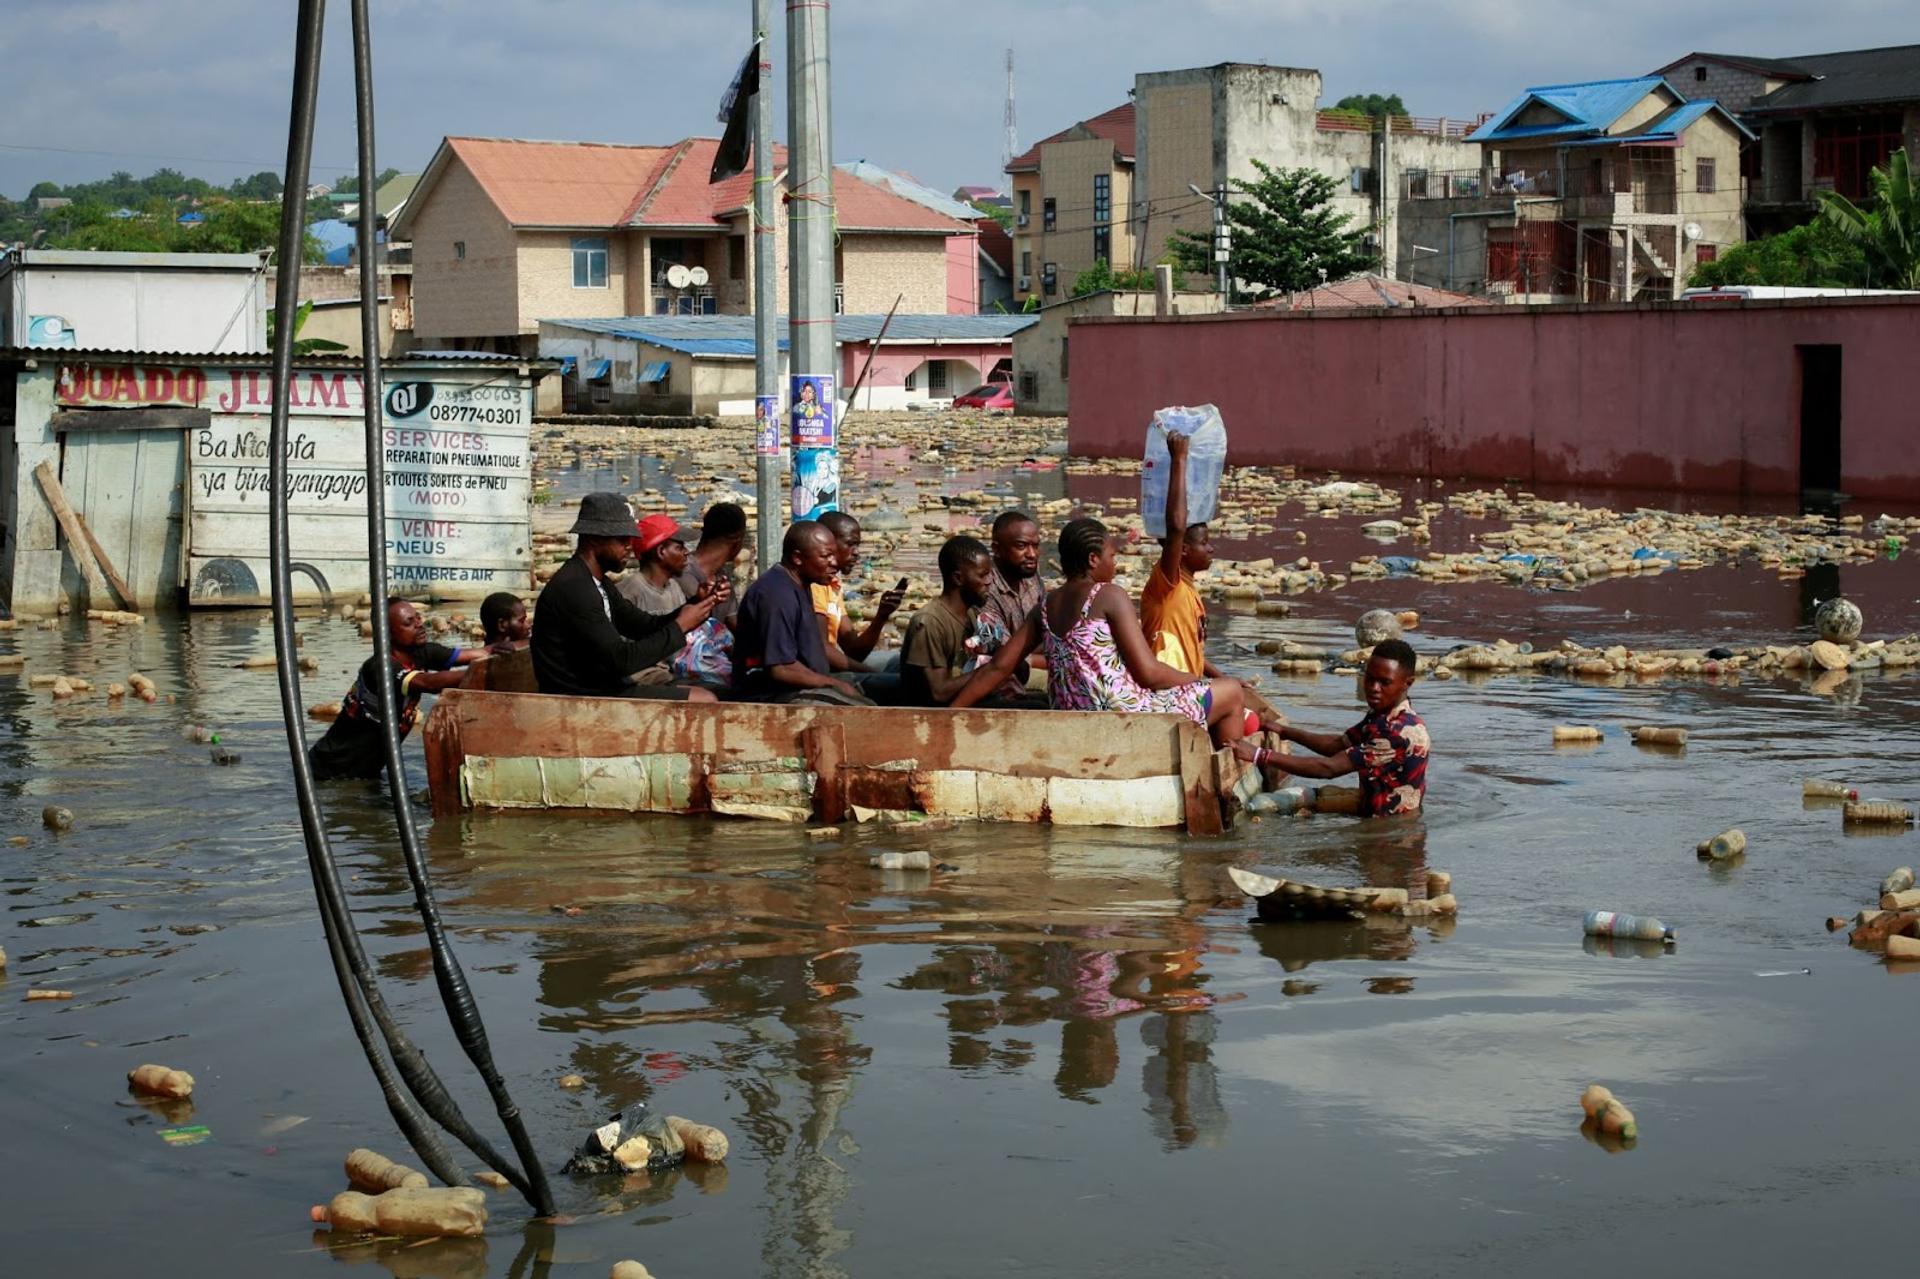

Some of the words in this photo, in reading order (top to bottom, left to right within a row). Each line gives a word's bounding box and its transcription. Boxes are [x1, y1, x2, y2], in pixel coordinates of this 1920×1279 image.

[57, 365, 207, 403] QUADO
[391, 384, 418, 414] QJ
[430, 405, 521, 424] 0897740301
[199, 430, 227, 457] Ba
[231, 431, 316, 459] Nicofa
[385, 430, 489, 451] SERVICES:
[386, 449, 448, 465] REPARATION
[451, 453, 521, 468] PNEUMATIQUE
[199, 472, 226, 497] ya
[430, 475, 462, 489] SORTES
[465, 475, 477, 489] de
[479, 476, 508, 490] PNEU
[408, 490, 467, 506] (MOTO)
[402, 520, 462, 538] VENTE:
[471, 569, 494, 581] AIR
